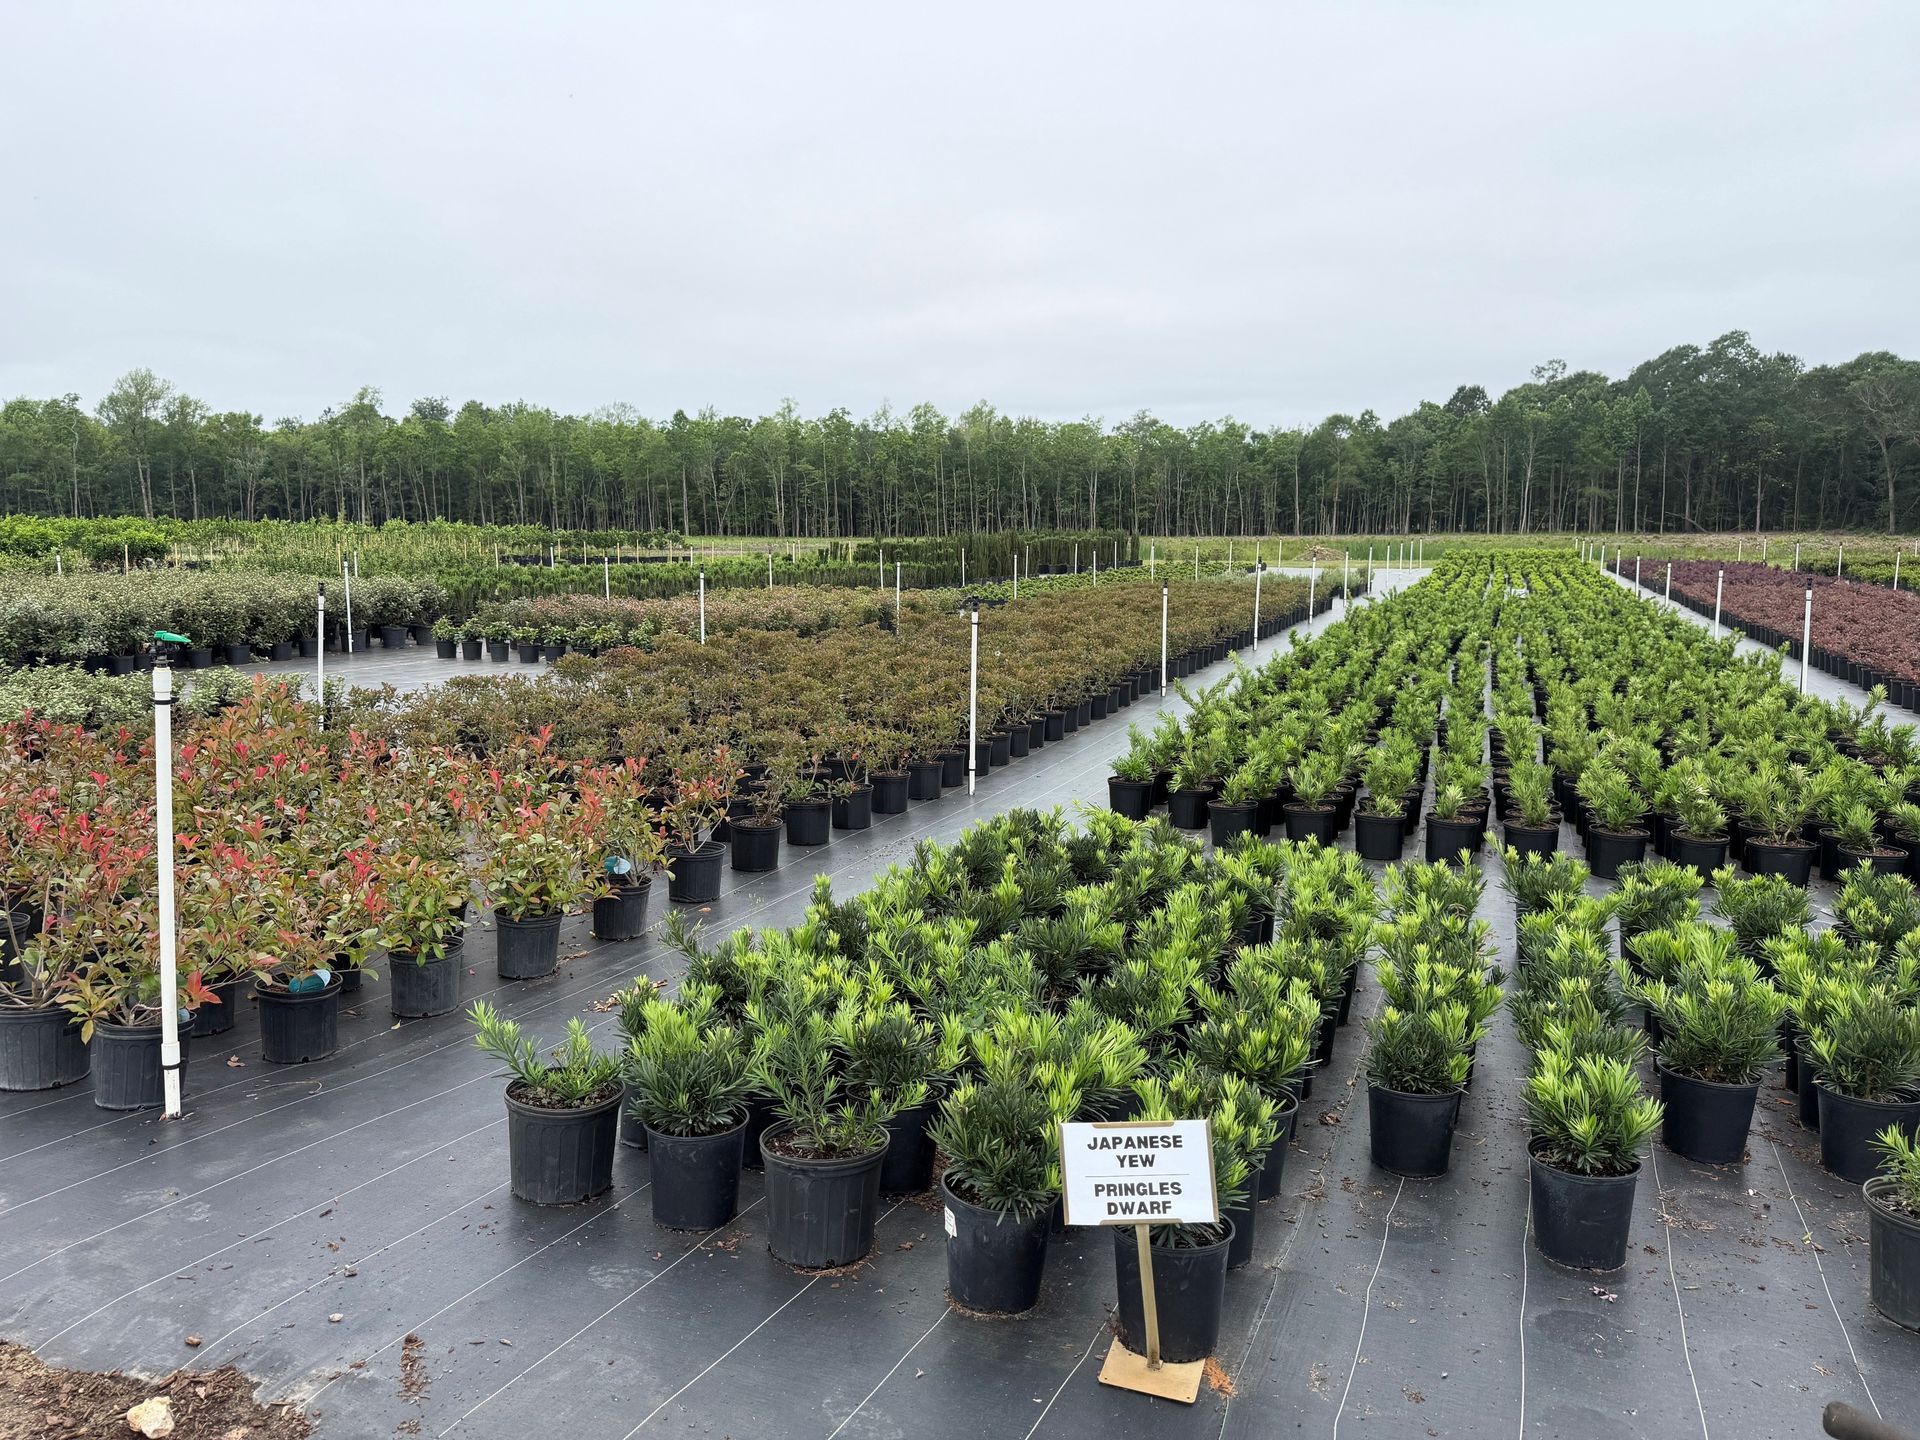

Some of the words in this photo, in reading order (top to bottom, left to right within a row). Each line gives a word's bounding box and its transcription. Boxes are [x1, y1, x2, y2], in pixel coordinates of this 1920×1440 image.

[1087, 1135, 1183, 1150] JAPANESE
[1116, 1154, 1156, 1168] YEW
[1094, 1182, 1182, 1197] PRINGLES
[1107, 1200, 1172, 1215] DWARF
